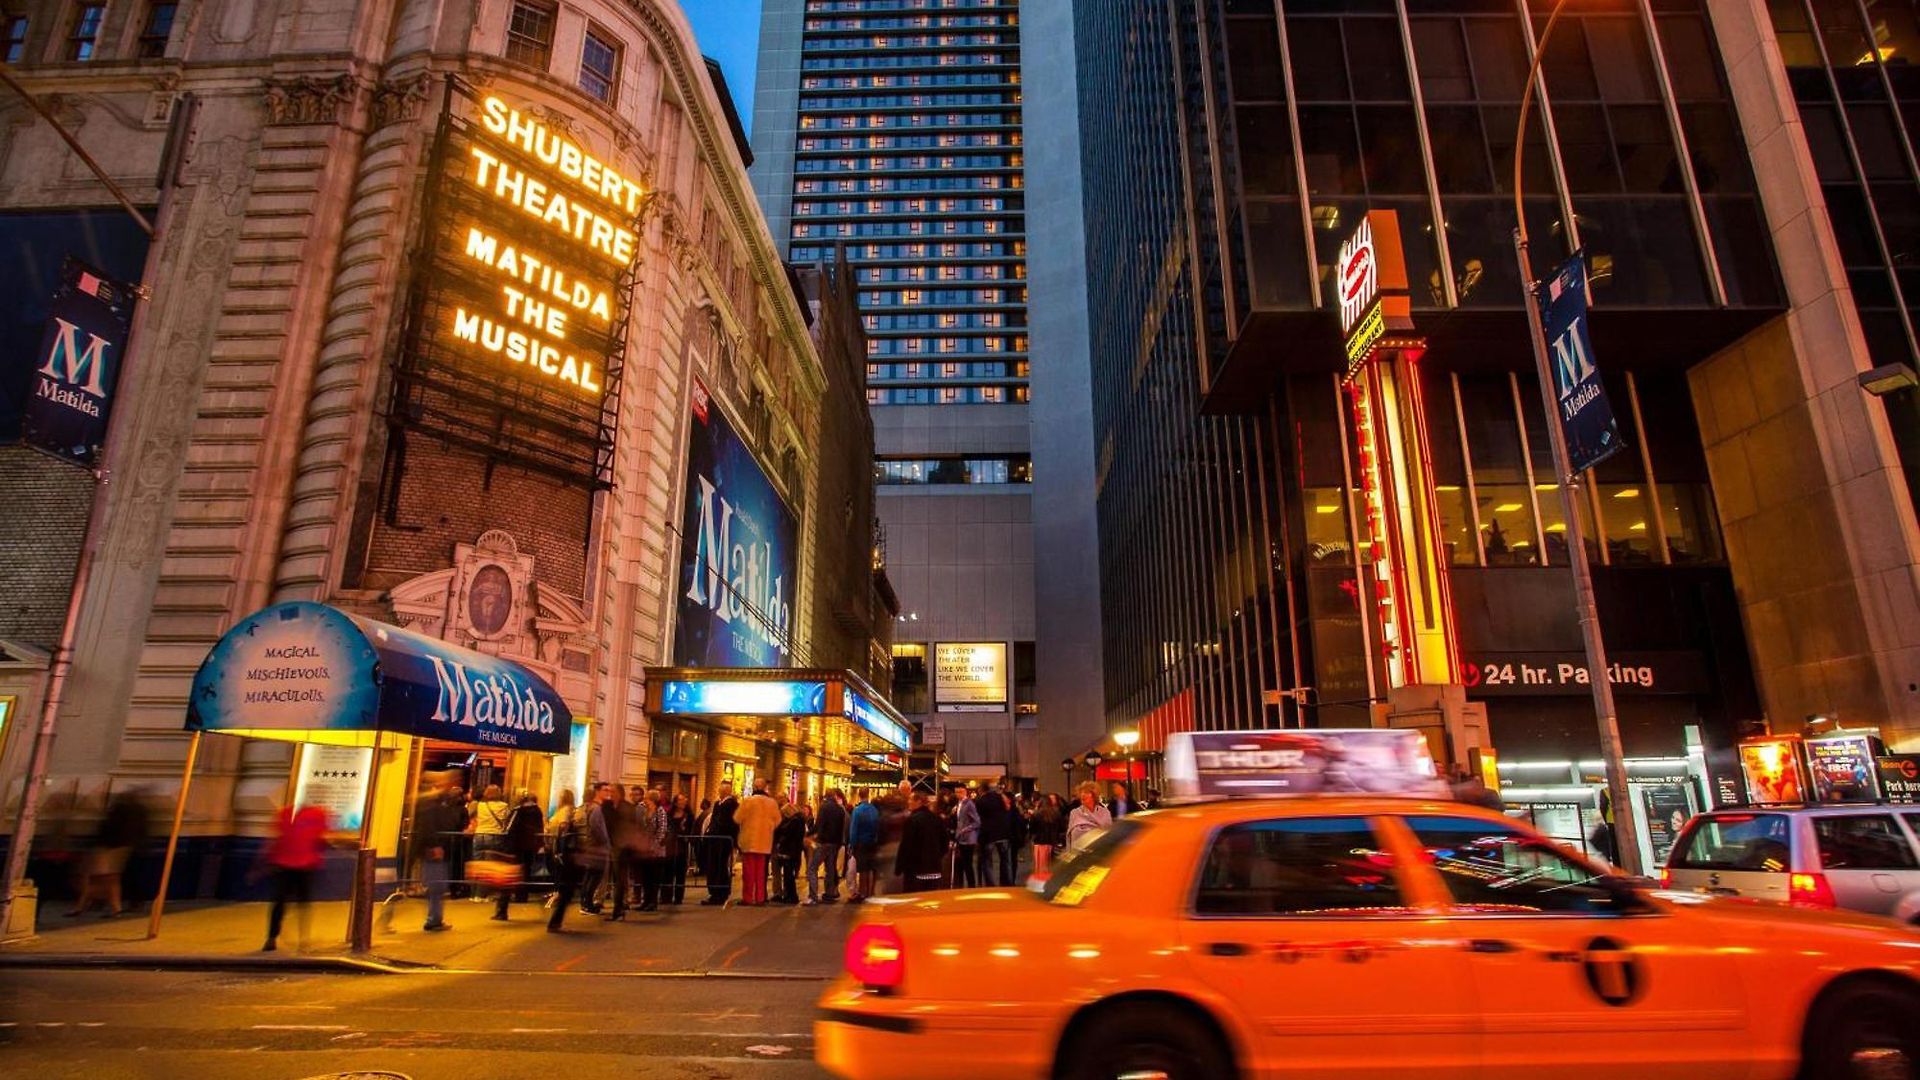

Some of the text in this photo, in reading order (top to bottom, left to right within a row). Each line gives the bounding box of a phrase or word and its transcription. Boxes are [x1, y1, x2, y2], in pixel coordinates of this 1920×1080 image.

[482, 96, 643, 213] SHUBERT
[471, 147, 635, 264] THEATRE
[465, 227, 610, 321] MATILDA
[504, 286, 567, 339] THE
[38, 317, 112, 399] M
[453, 308, 599, 393] MUSICAL
[1552, 316, 1596, 400] M
[36, 378, 100, 418] Matilda
[1564, 382, 1601, 422] Matilda
[686, 473, 790, 656] Matilda
[264, 645, 320, 658] MAGICAL.
[971, 665, 994, 673] COVER
[246, 666, 330, 681] MISCHIEVOUS.
[1484, 663, 1654, 687] 24 hr. Paking
[425, 654, 555, 734] Matilda
[478, 729, 517, 745] THE MUSICAL
[1200, 750, 1304, 768] THOR
[1828, 763, 1851, 772] FIRST
[1885, 780, 1903, 792] Park
